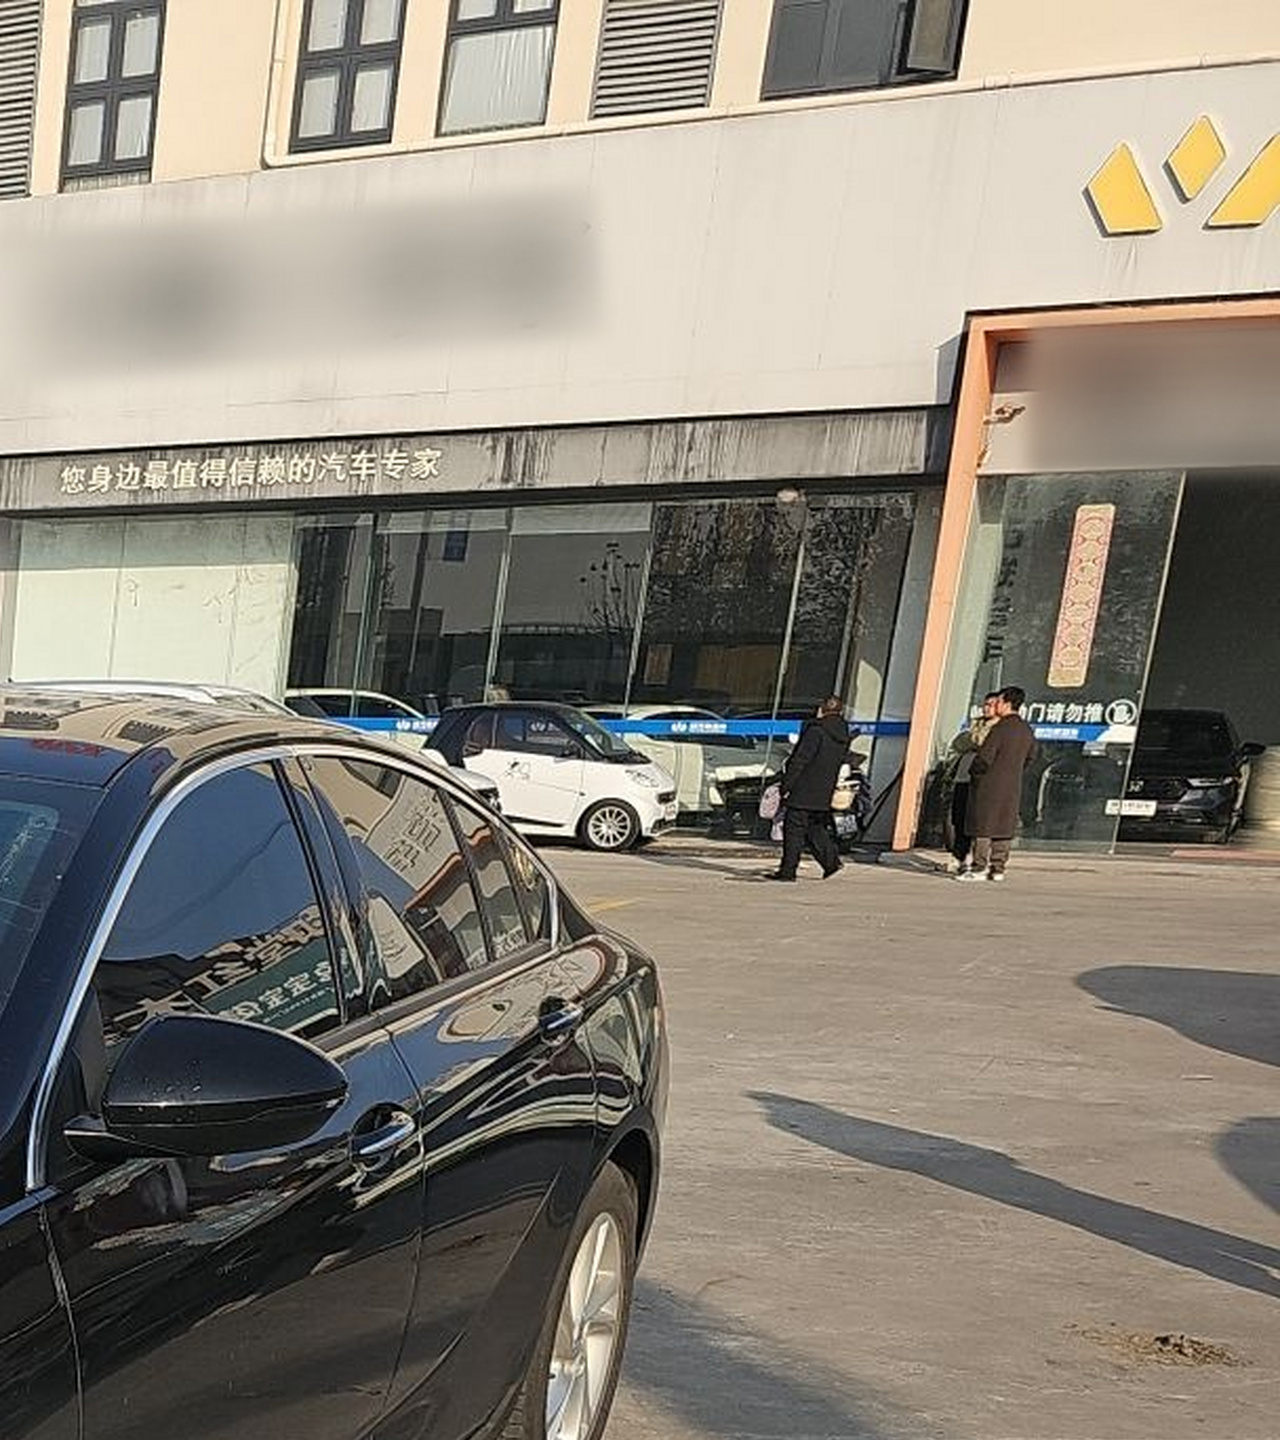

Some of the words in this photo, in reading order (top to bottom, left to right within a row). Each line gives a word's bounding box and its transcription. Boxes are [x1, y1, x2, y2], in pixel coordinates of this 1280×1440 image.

[60, 448, 442, 494] 您身边最值得信赖的汽车专家
